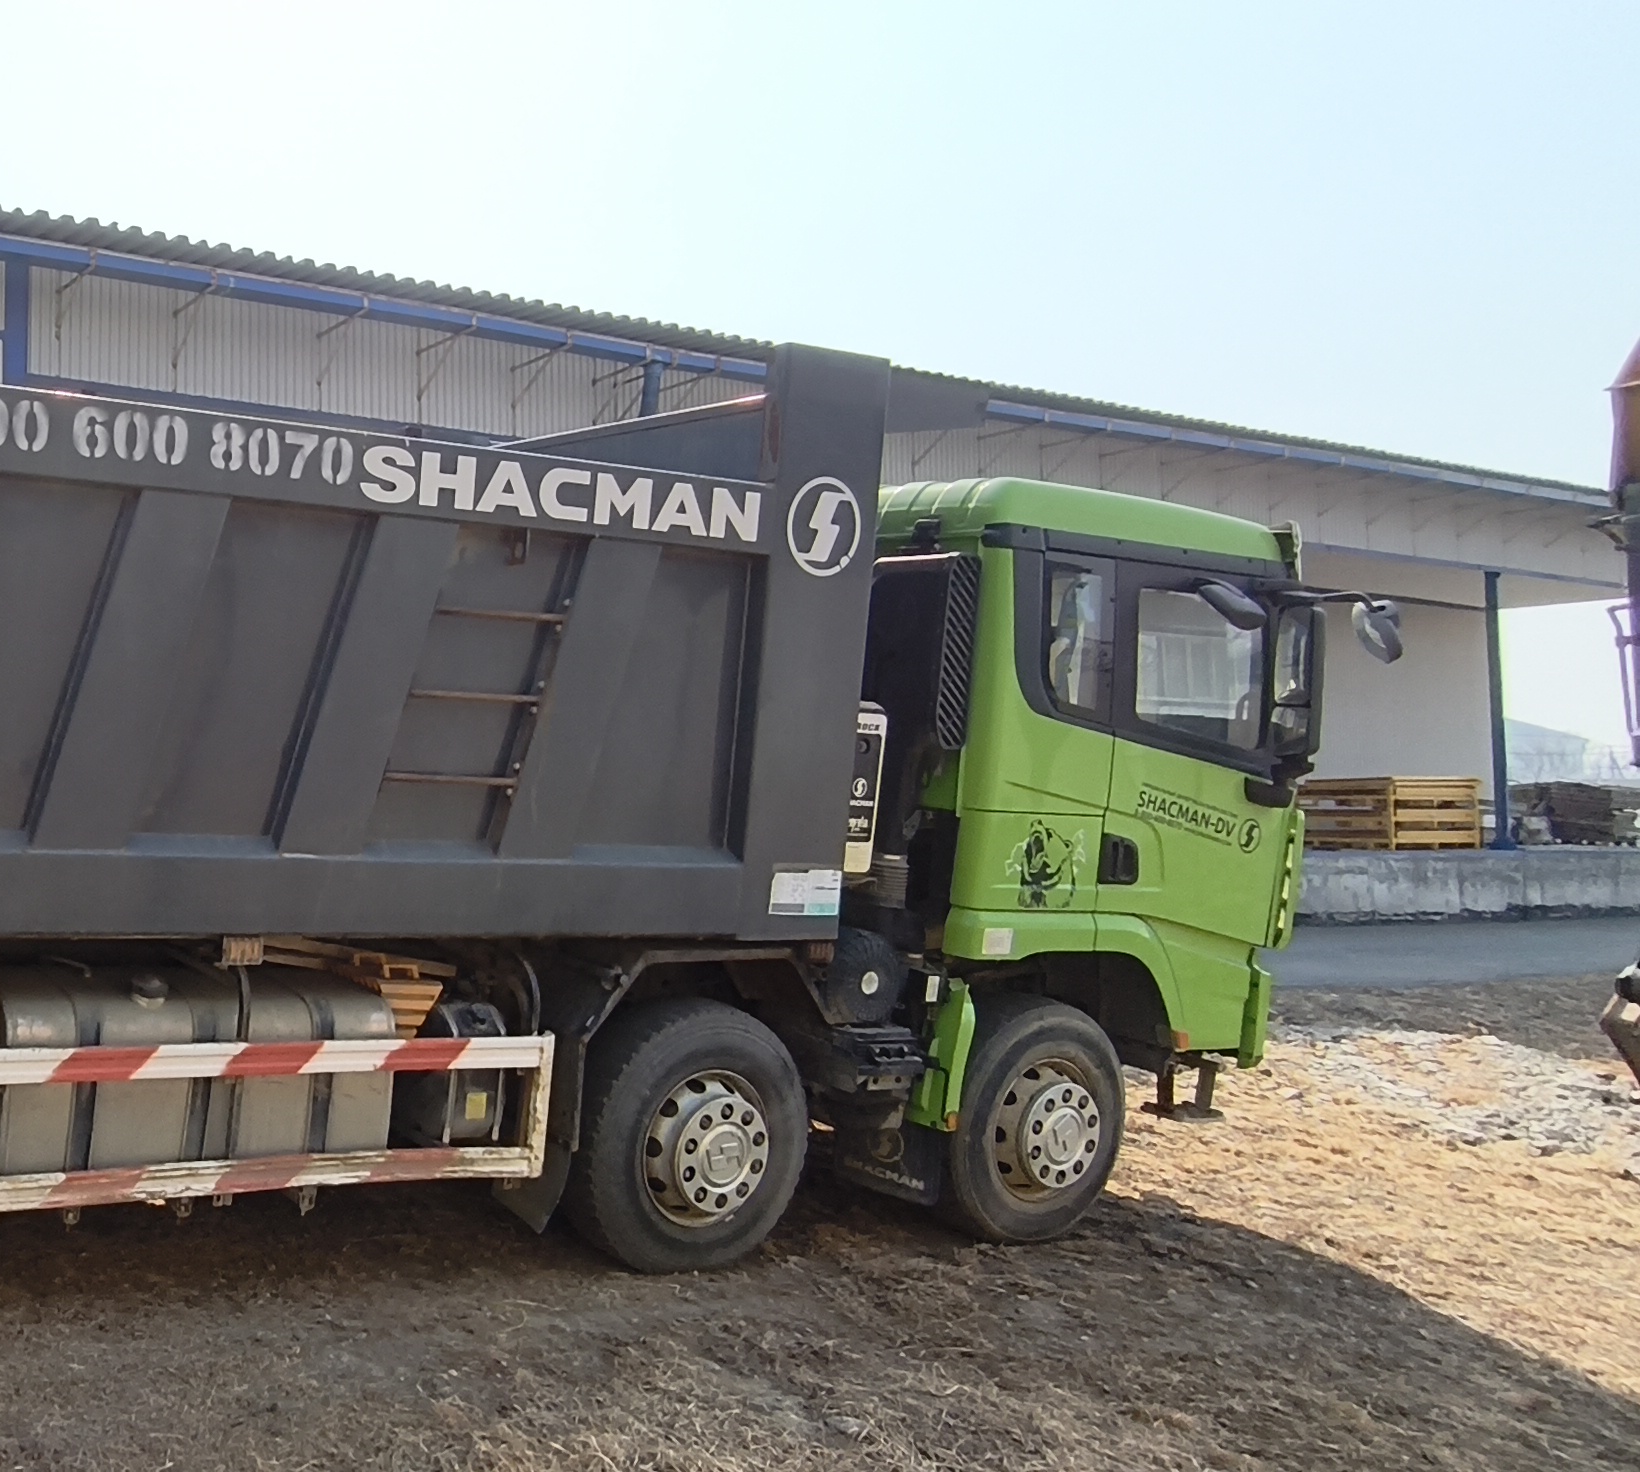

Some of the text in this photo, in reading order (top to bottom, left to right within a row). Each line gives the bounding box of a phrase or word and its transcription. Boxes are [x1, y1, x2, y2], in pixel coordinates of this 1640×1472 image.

[73, 405, 189, 466] 600
[209, 421, 354, 486] 8070
[360, 445, 762, 543] SHACMAN
[1137, 791, 1236, 837] SHACMAN-DV
